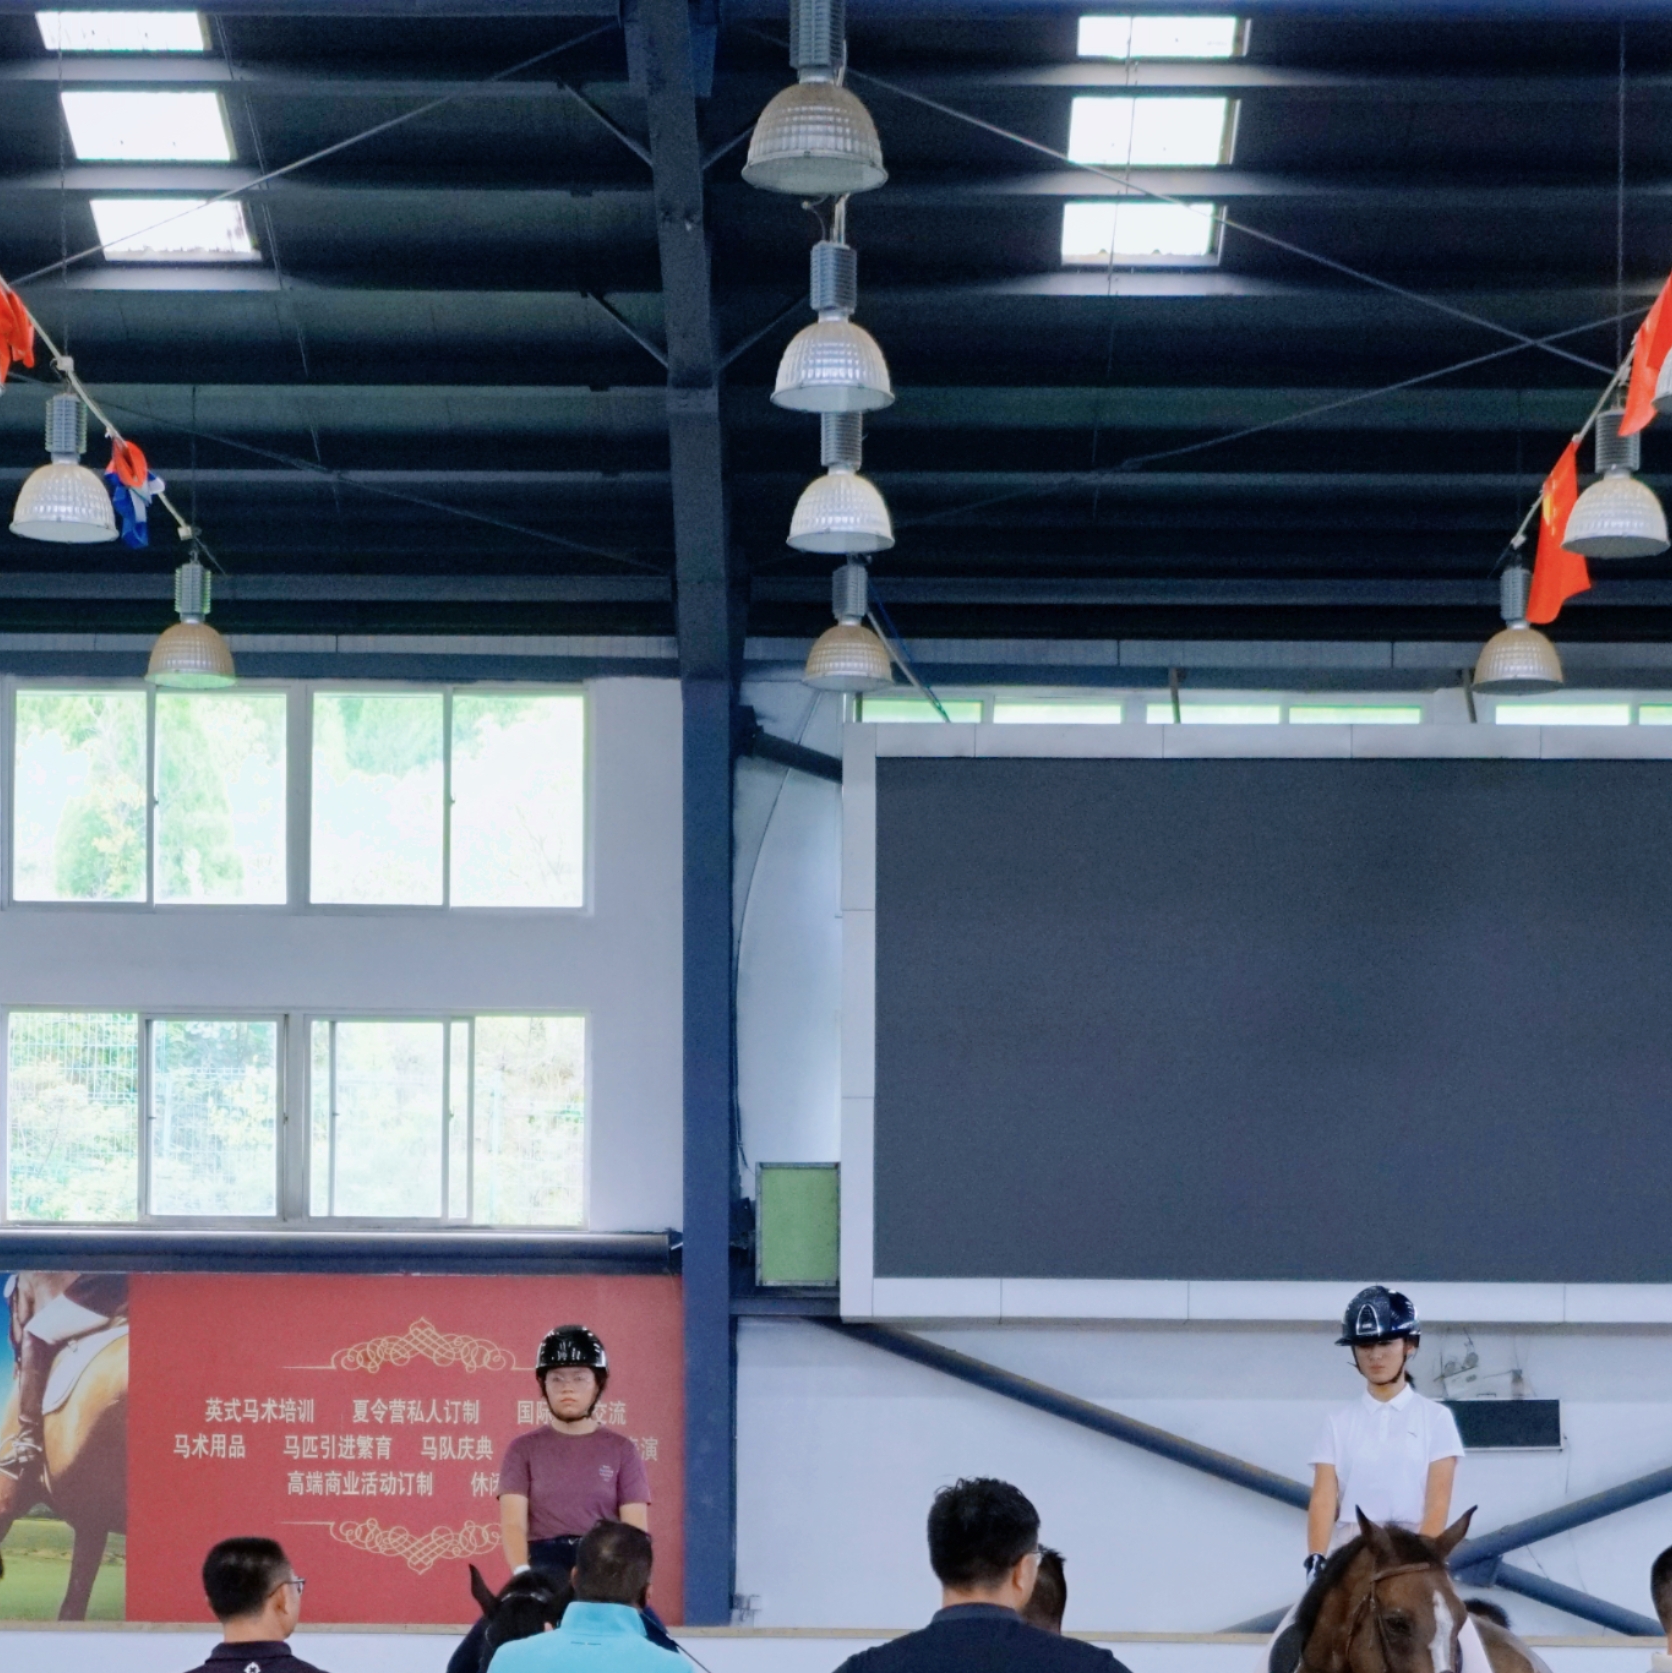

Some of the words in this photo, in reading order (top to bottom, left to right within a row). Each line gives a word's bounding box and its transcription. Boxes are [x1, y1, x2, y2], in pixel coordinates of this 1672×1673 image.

[205, 1397, 315, 1423] 英式马术培训
[352, 1398, 480, 1424] 夏令营私人订制
[173, 1433, 246, 1459] 马术用品
[283, 1434, 393, 1459] 马匹引进繁育
[420, 1435, 493, 1460] 马队庆典
[287, 1470, 433, 1497] 高端商业活动订制
